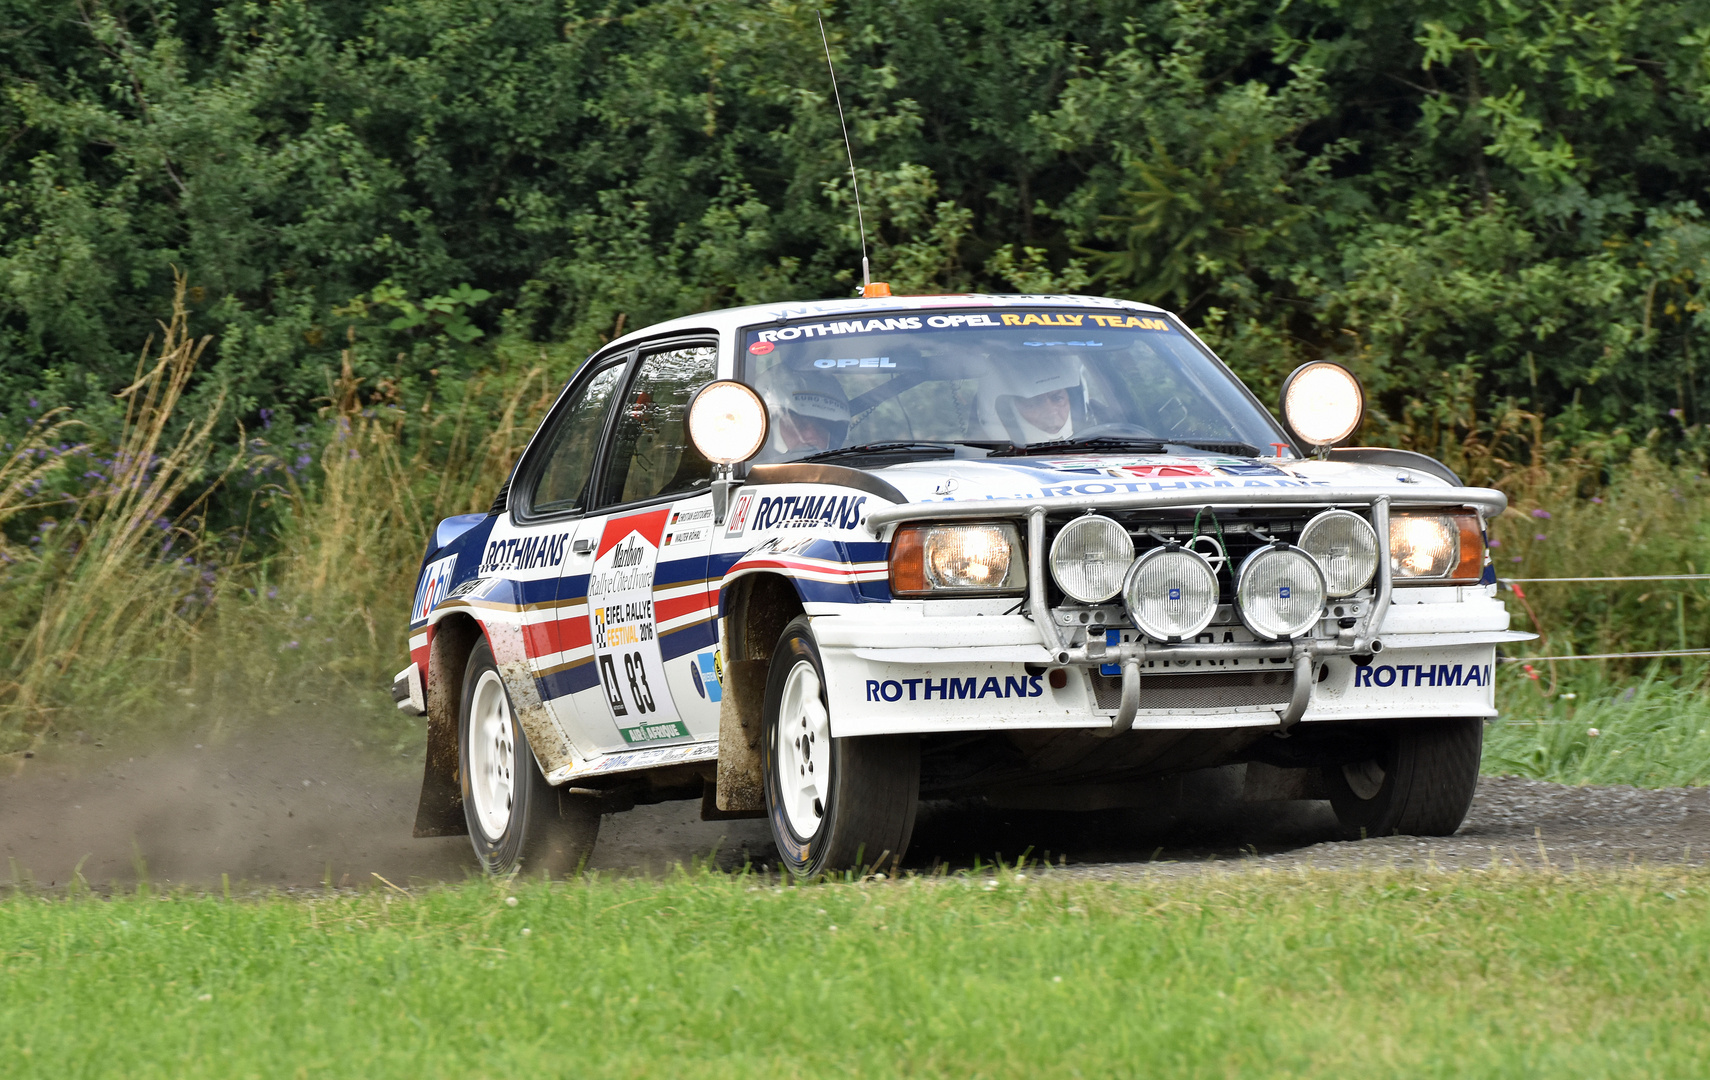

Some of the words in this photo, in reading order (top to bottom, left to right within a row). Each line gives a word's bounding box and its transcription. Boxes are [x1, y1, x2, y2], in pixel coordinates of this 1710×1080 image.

[758, 317, 923, 342] ROTHMANS
[927, 314, 1001, 328] OPEL
[1001, 313, 1084, 327] RALLY
[1088, 314, 1169, 331] TEAM
[814, 357, 896, 368] OPEL
[752, 496, 867, 530] ROTHMANS
[480, 533, 569, 573] ROTHMANS
[611, 536, 644, 569] Marlboro
[411, 558, 458, 620] Mobil
[589, 572, 613, 600] Rallye
[605, 604, 624, 625] EIFEL
[625, 599, 651, 621] RALLYE
[607, 625, 638, 647] FESTIVAL
[640, 623, 653, 641] 2016
[624, 652, 656, 714] 83
[866, 675, 1043, 702] ROTHMANS
[646, 723, 680, 741] AFRIQUE
